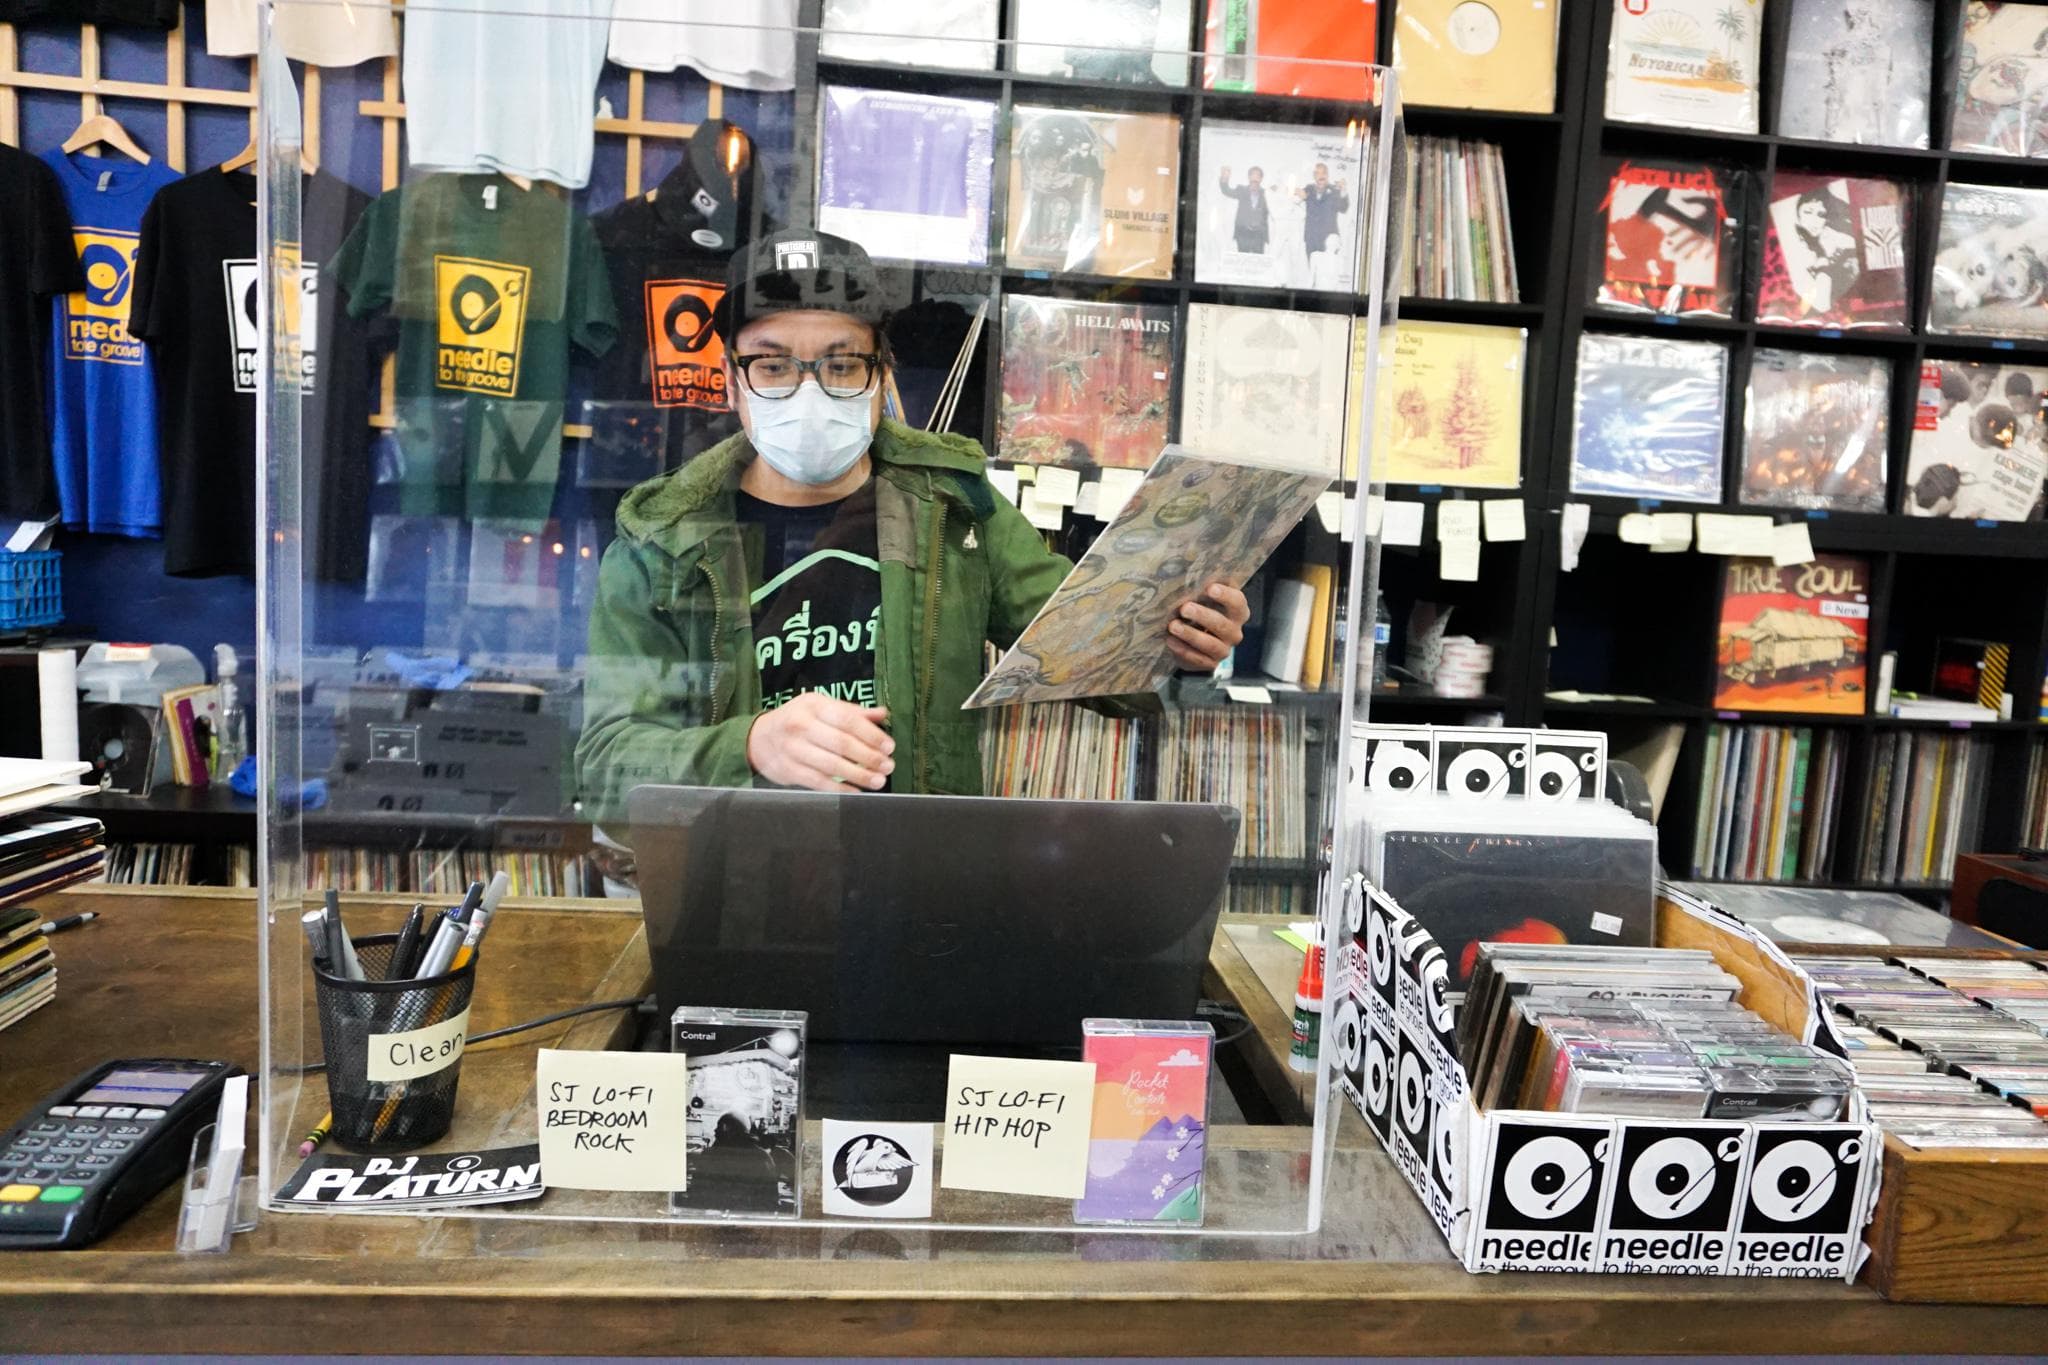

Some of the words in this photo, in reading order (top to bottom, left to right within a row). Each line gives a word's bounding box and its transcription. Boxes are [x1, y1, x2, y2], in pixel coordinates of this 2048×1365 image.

[1075, 314, 1114, 329] HELL
[1118, 317, 1171, 333] AWAITS
[439, 348, 514, 376] needle
[657, 366, 726, 391] needle
[1729, 562, 1787, 594] TRUE
[1794, 562, 1863, 599] SOUL
[1834, 605, 1860, 616] New
[1389, 835, 1462, 845] STRANGE
[1474, 837, 1534, 847] THINGS
[680, 1030, 717, 1042] Contrail
[389, 1032, 464, 1067] Clean
[550, 1081, 581, 1103] SJ
[592, 1085, 654, 1106] LO-FI
[957, 1086, 995, 1107] SJ
[997, 1090, 1066, 1115] LO-FI
[1722, 1096, 1759, 1107] Contrail
[545, 1108, 648, 1129] BEDROOM
[573, 1131, 636, 1154] ROCK
[954, 1114, 999, 1137] HIP
[1001, 1116, 1052, 1149] HOP
[363, 1156, 419, 1177] DJ
[292, 1162, 541, 1202] PLATURN
[1604, 1233, 1724, 1261] needle
[1625, 1261, 1653, 1274] the
[1744, 1263, 1772, 1277] the
